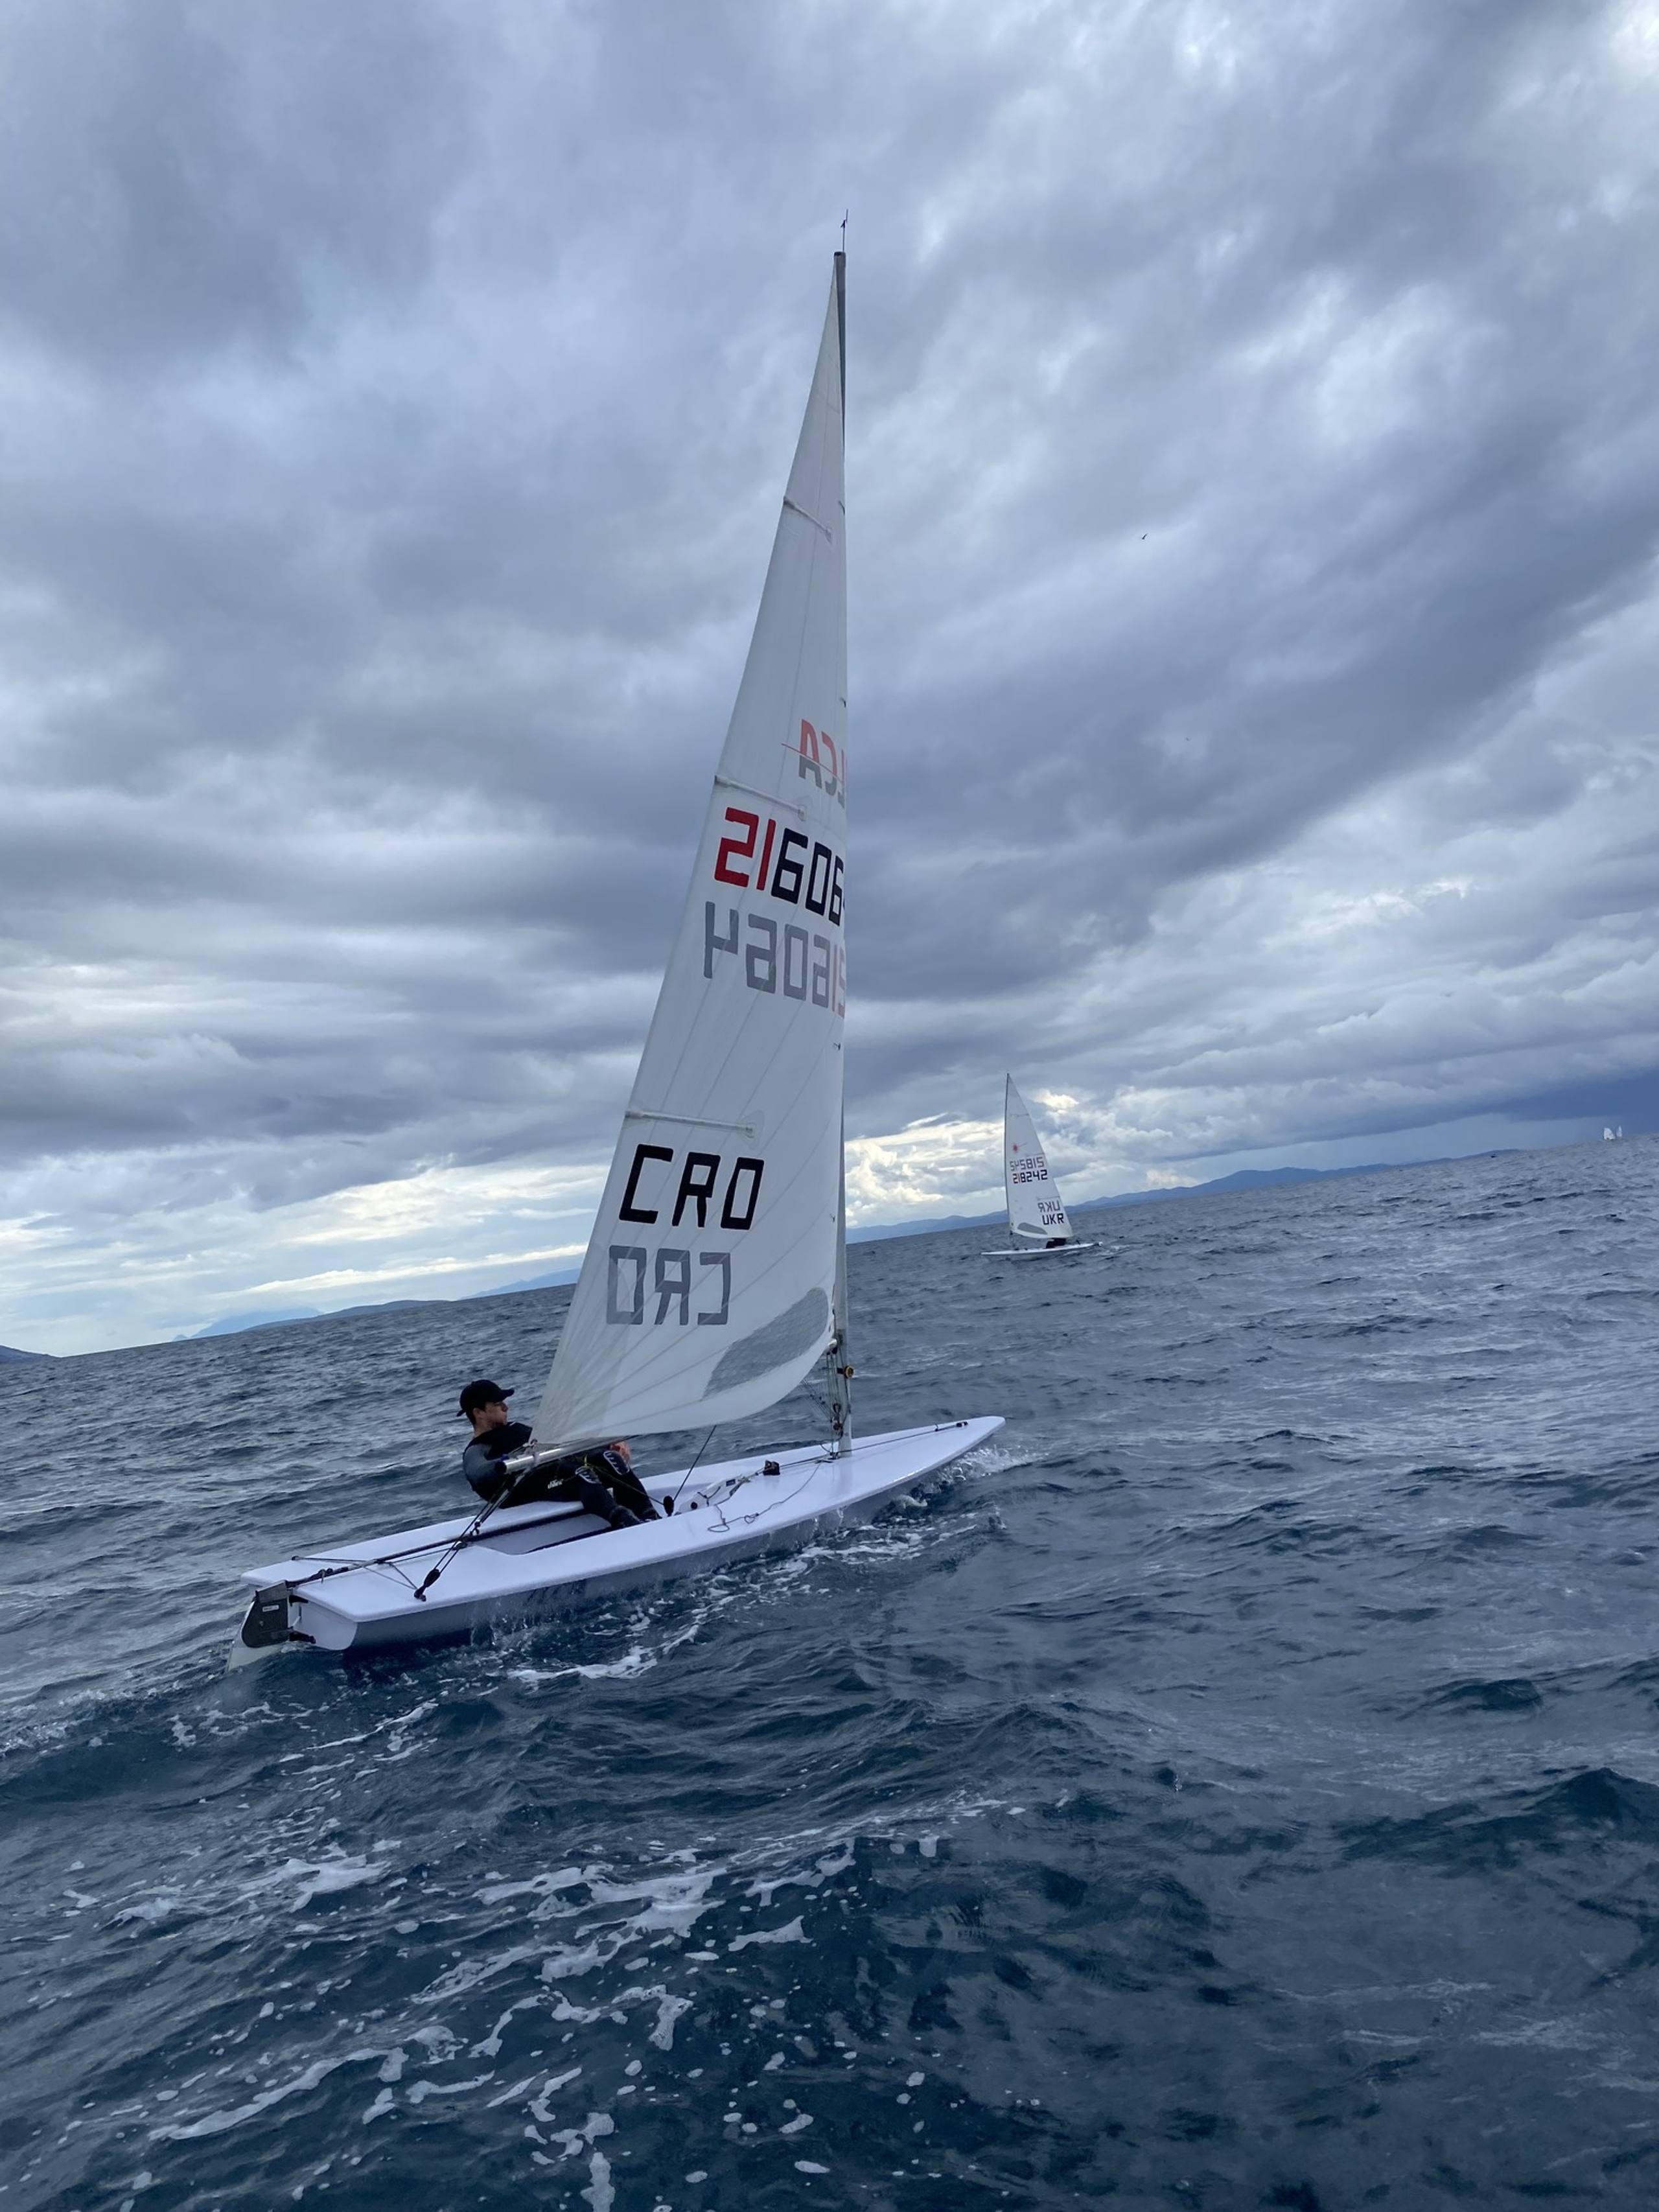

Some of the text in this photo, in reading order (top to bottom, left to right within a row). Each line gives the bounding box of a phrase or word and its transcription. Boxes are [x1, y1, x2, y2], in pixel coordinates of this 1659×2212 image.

[714, 806, 845, 927] 21606
[618, 1143, 765, 1230] CRO
[1012, 1169, 1048, 1183] 218242
[1042, 1213, 1064, 1225] UKR
